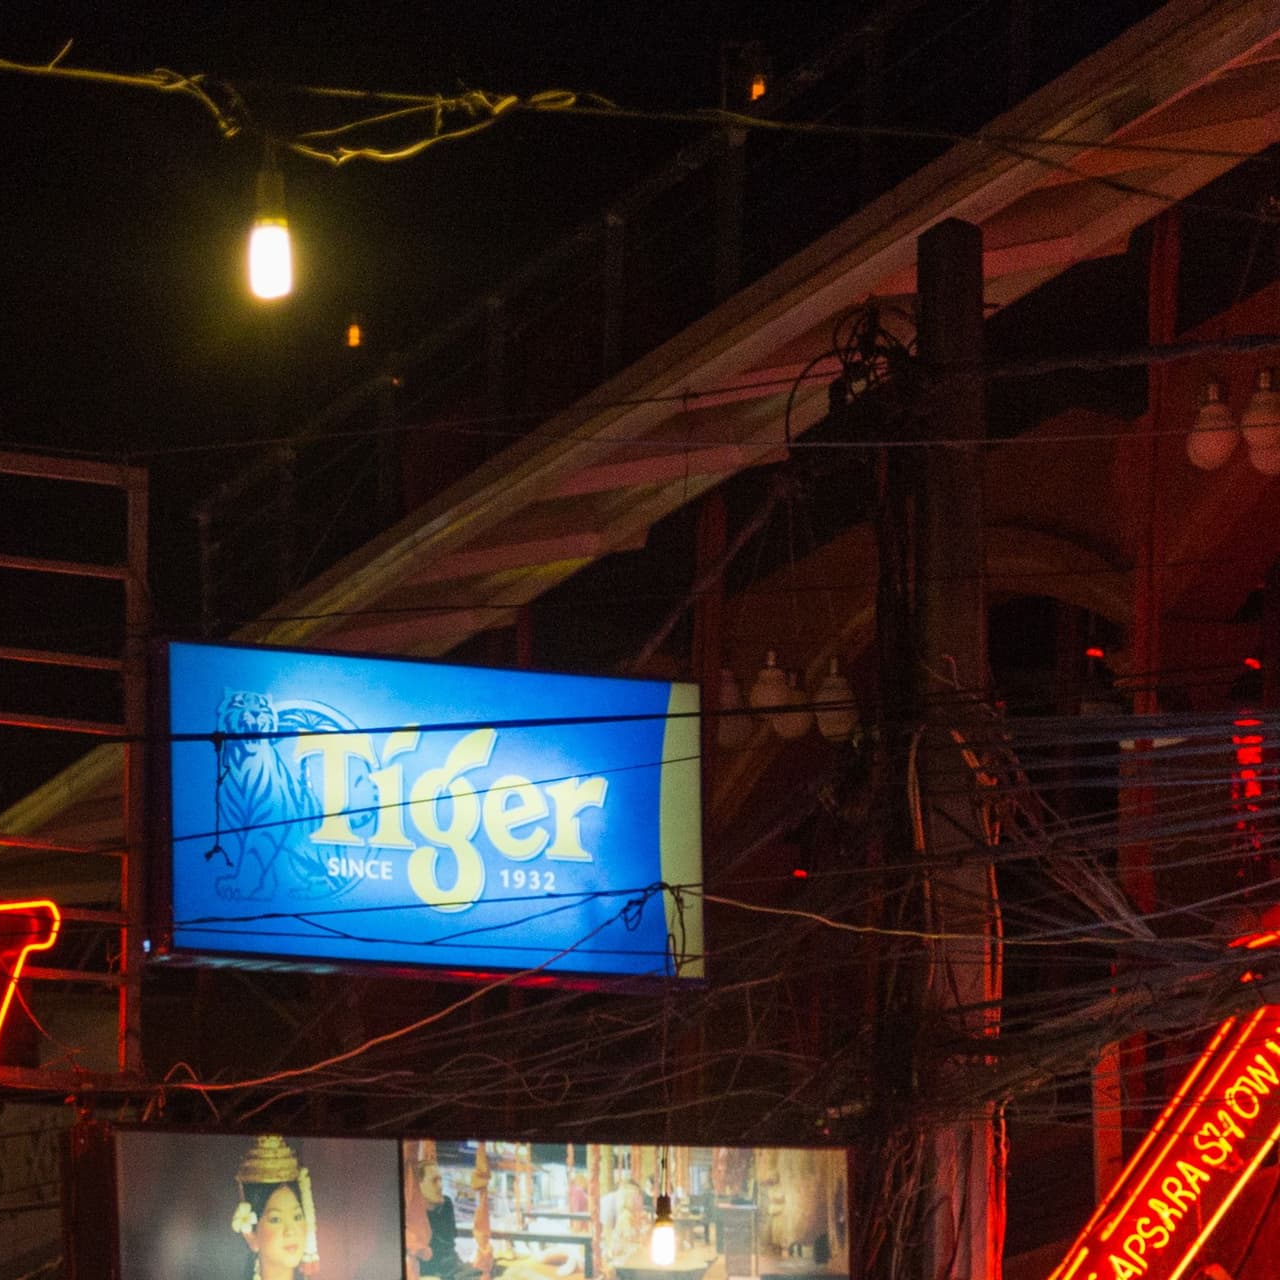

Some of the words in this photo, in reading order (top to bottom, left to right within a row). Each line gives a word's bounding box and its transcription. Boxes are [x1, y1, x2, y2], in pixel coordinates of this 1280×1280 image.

[296, 723, 608, 913] Tiger
[328, 857, 393, 881] SINCE
[499, 868, 556, 890] 1932
[1193, 1053, 1280, 1167] SHOW
